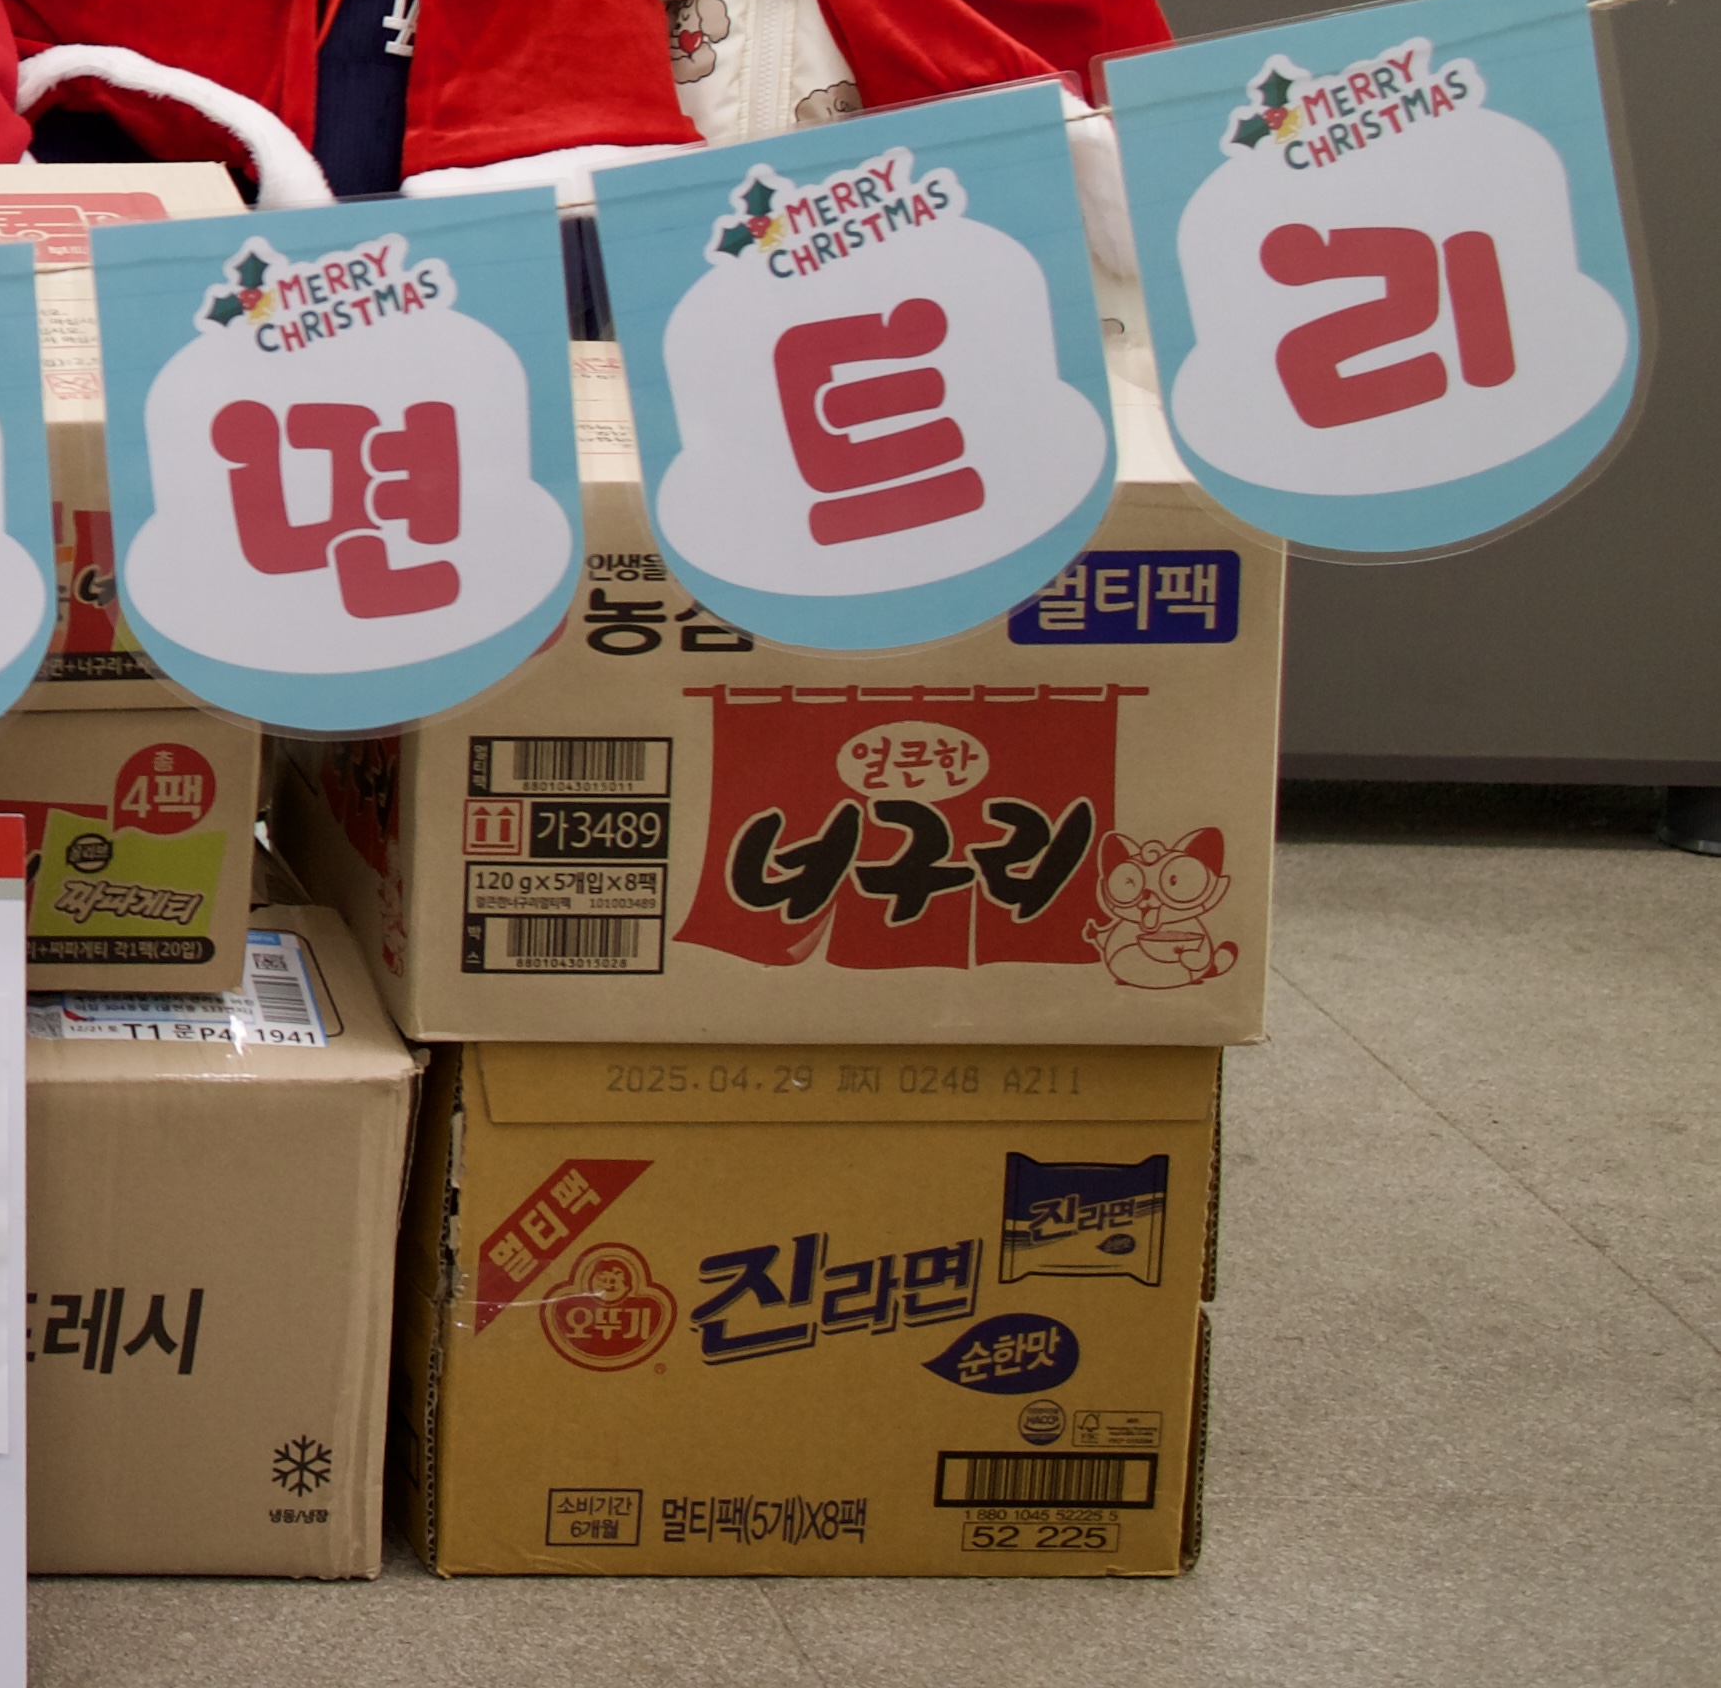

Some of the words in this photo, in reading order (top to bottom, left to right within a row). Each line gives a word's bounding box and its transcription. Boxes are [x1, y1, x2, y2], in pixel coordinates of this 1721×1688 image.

[1301, 49, 1418, 128] MERRY
[1283, 69, 1467, 171] CHRISTMAS
[785, 159, 898, 235] MERRY
[768, 180, 950, 278] CHRISTMAS
[277, 245, 392, 310] MERRY
[256, 268, 439, 353] CHRISTMAS
[1258, 222, 1517, 430] 리
[773, 298, 986, 546] 트
[210, 399, 462, 620] 면
[152, 750, 175, 773] 총
[850, 734, 981, 790] 얼큰한
[120, 773, 204, 821] 4팩
[536, 809, 662, 852] 가3489
[475, 872, 515, 890] 120
[724, 795, 1098, 928] 너구리
[55, 880, 205, 926] 짜파게티
[256, 1028, 318, 1045] 1941
[605, 1063, 815, 1097] 2025.04.29
[899, 1064, 980, 1097] 0248
[1002, 1065, 1084, 1097] A211
[486, 1167, 603, 1284] 멀티팩
[1029, 1192, 1137, 1244] 진라면
[563, 1303, 655, 1343] 오뚜기
[689, 1230, 983, 1368] 진라면
[957, 1325, 1062, 1386] 순한맛
[268, 1508, 330, 1525] 냉동/냉장
[556, 1495, 633, 1516] 소비기간
[570, 1519, 620, 1540] 6개월
[971, 1525, 1021, 1549] 52
[1035, 1525, 1108, 1549] 225
